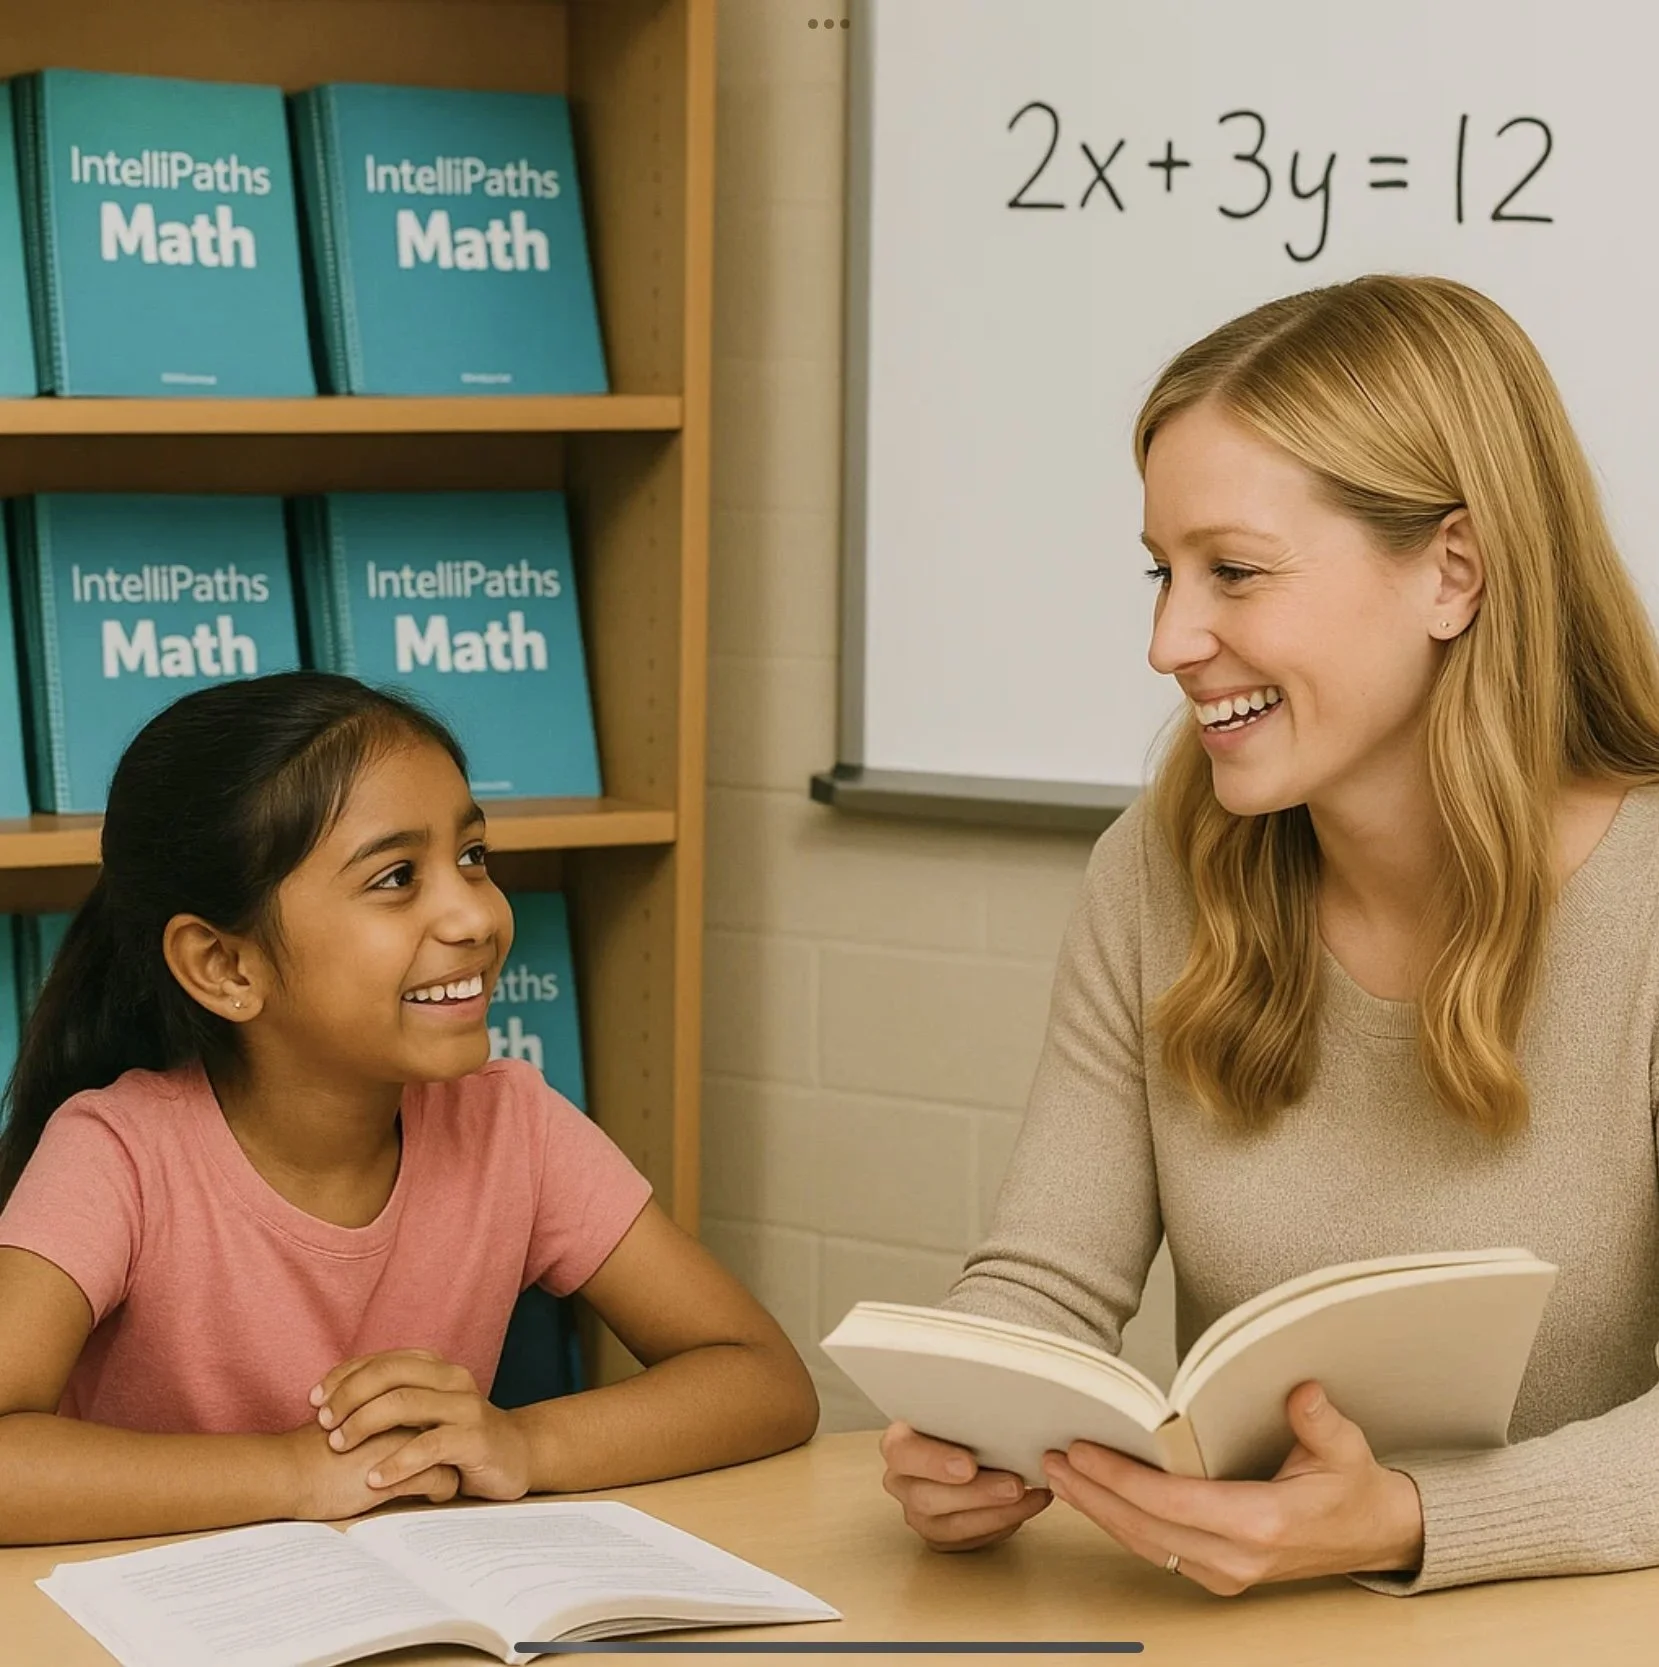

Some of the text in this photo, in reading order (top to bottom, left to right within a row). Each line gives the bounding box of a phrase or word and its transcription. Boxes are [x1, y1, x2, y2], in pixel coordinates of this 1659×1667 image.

[70, 146, 271, 195] IntelliPaths
[365, 155, 560, 199] IntelliPaths
[1456, 113, 1553, 224] 12
[101, 202, 256, 268] Math
[397, 209, 549, 271] Math
[72, 564, 269, 602] IntelliPaths
[367, 560, 561, 599] IntelliPaths
[102, 616, 257, 678] Math
[395, 611, 548, 672] Math
